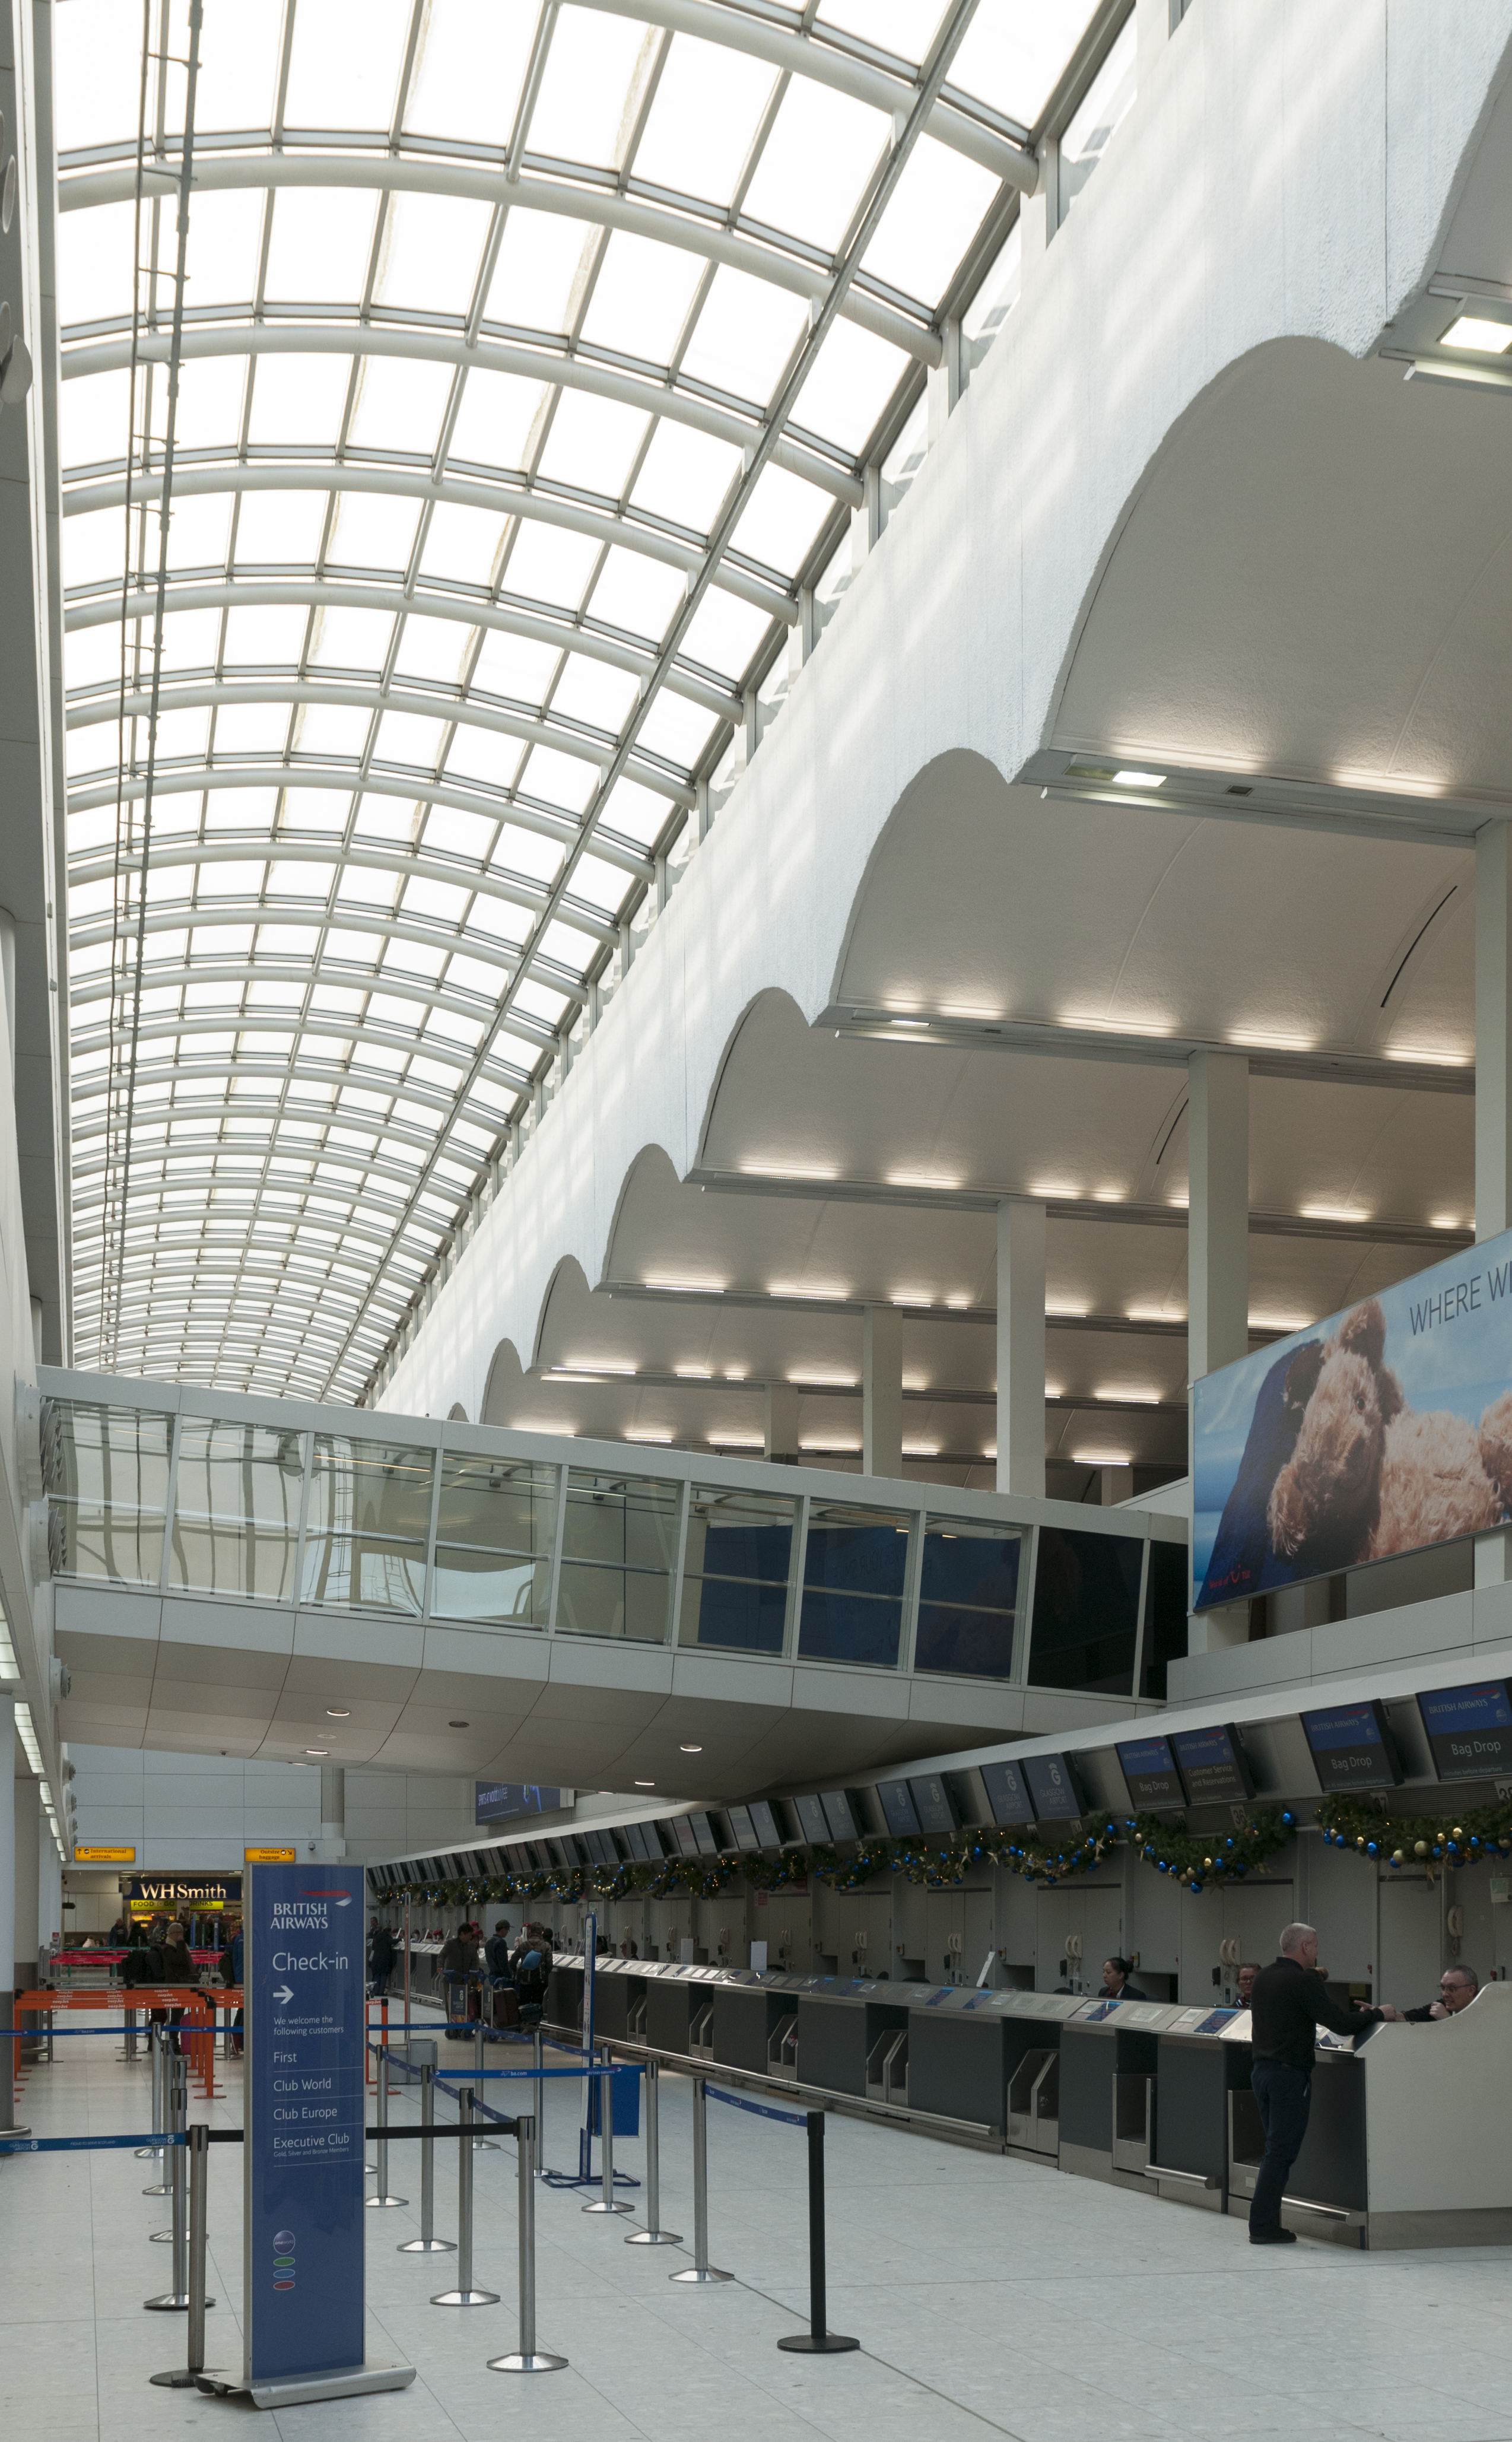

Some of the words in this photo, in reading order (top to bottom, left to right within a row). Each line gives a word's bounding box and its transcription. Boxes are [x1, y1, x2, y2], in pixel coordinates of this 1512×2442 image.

[1409, 1275, 1482, 1336] WHERE
[1429, 1703, 1457, 1714] BRITISH
[1457, 1698, 1488, 1710] AIRWAYS
[1310, 1722, 1334, 1732] BRITISH
[1335, 1718, 1359, 1729] AIRWAYS
[1179, 1743, 1197, 1751] BRITISH
[1197, 1739, 1218, 1748] AIRWAYS
[1451, 1744, 1473, 1757] Bag
[1473, 1741, 1501, 1754] Drop
[1141, 1749, 1158, 1757] AIRWAYS
[1331, 1759, 1349, 1771] Bag
[1349, 1757, 1372, 1768] Drop
[1188, 1767, 1213, 1777] Customer
[1212, 1764, 1233, 1774] Service
[1478, 1767, 1503, 1775] departure
[1139, 1783, 1152, 1793] Bag
[1152, 1781, 1169, 1792] Drop
[1192, 1779, 1202, 1787] and
[1202, 1776, 1237, 1786] Reservations
[1039, 1787, 1065, 1798] GLASGOW
[1049, 1796, 1068, 1805] AIRPORT
[1233, 1809, 1247, 1825] 36
[139, 1883, 227, 1900] WHSmith
[274, 1903, 327, 1915] BRITISH
[270, 1917, 328, 1929] AIRWAYS
[272, 1951, 348, 1971] Check-in
[274, 2017, 286, 2025] We
[288, 2016, 320, 2024] welcome
[274, 2027, 307, 2036] following
[274, 2052, 297, 2063] First
[274, 2079, 298, 2091] Club
[301, 2078, 331, 2090] World
[274, 2108, 298, 2120] Club
[302, 2107, 338, 2120] Europe
[274, 2135, 325, 2149] Executive
[328, 2132, 350, 2145] Club
